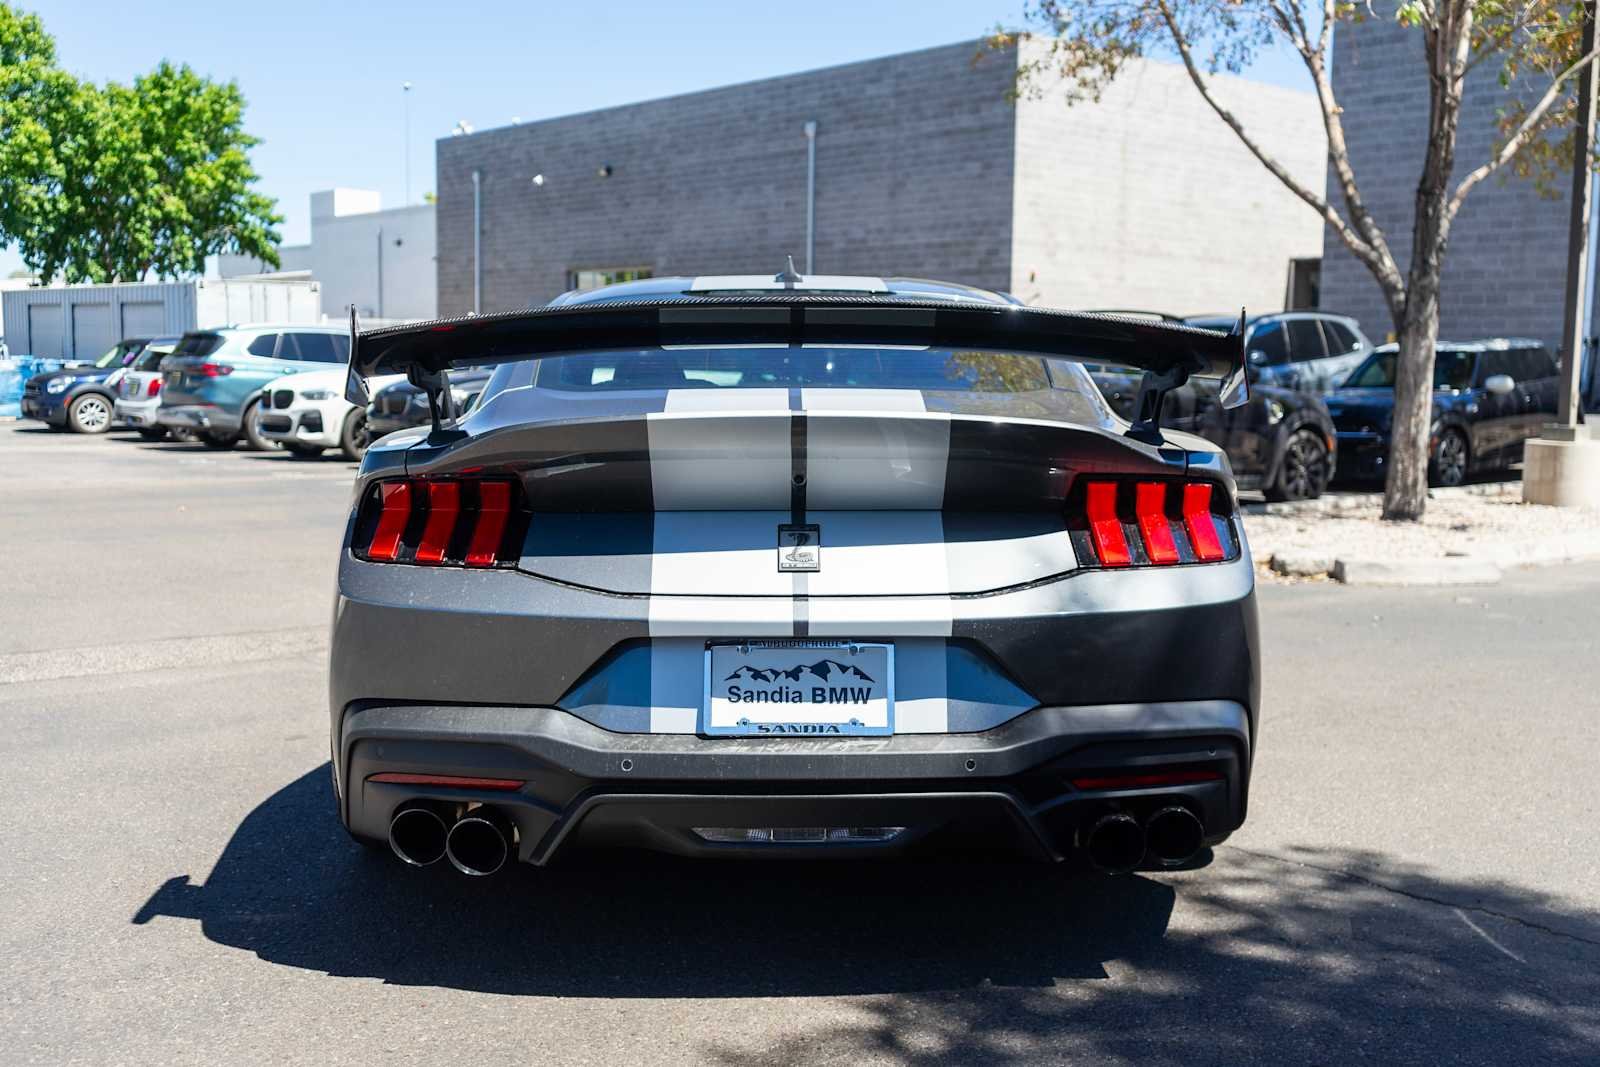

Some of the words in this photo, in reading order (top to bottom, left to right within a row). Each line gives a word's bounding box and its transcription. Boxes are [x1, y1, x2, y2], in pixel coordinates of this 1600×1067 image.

[727, 685, 803, 704] Sandia
[811, 687, 872, 705] BMW
[757, 725, 841, 733] SANDIA
